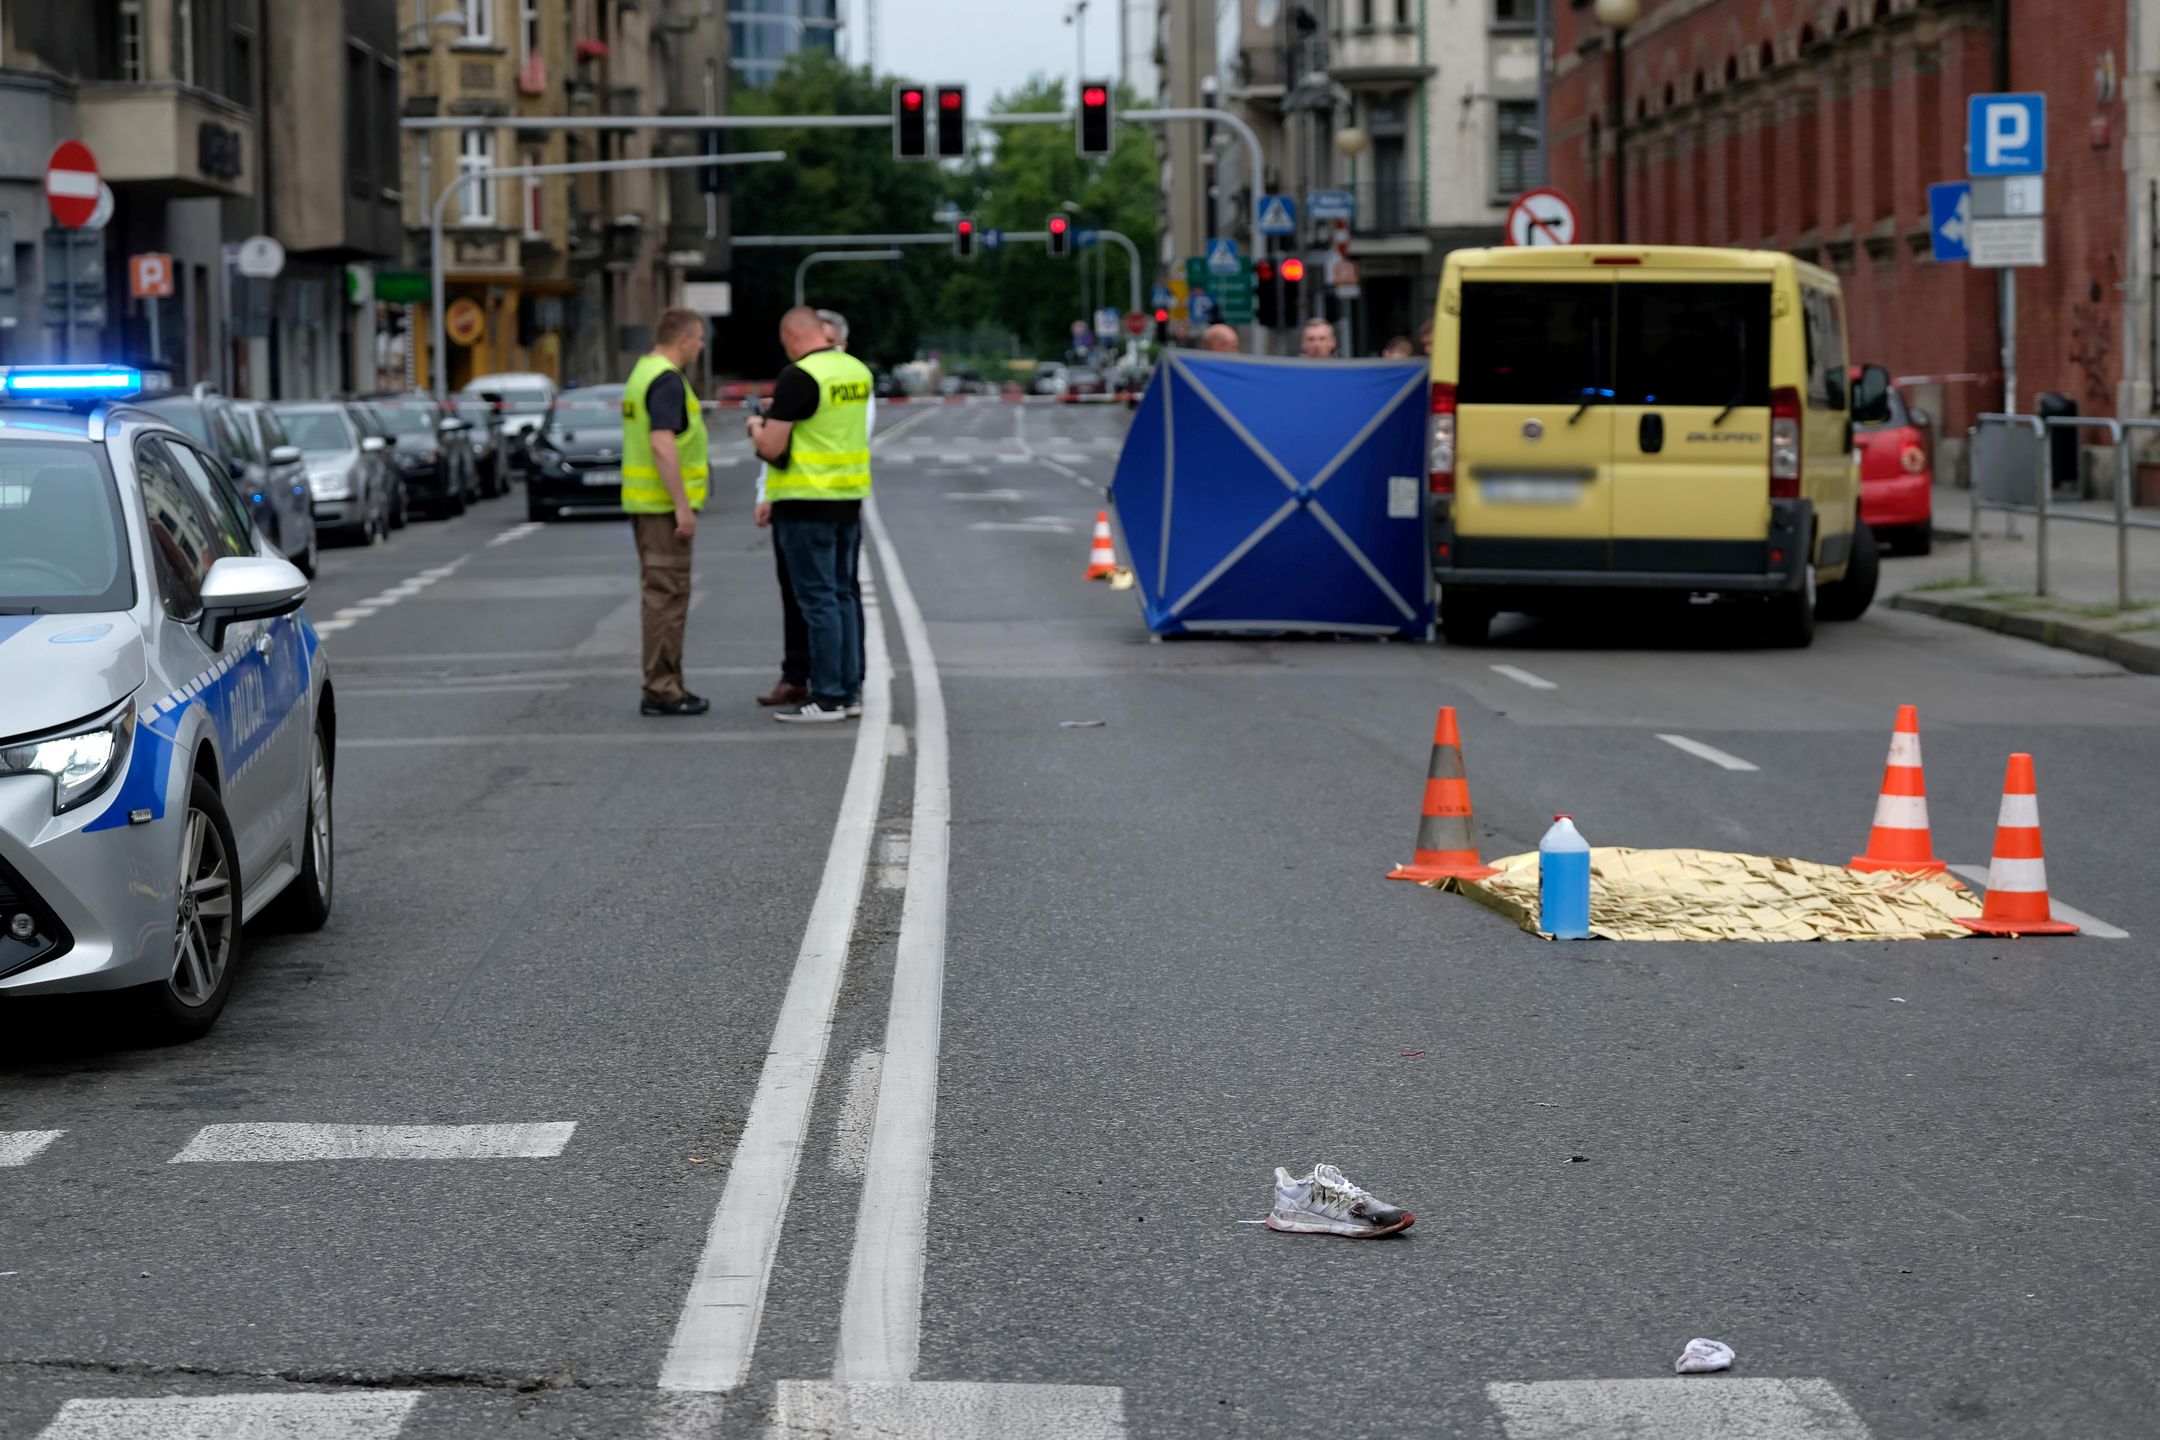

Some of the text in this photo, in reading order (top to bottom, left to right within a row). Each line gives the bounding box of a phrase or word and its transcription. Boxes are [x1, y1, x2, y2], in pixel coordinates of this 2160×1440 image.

[1986, 103, 2030, 167] P
[139, 259, 164, 292] P
[830, 383, 870, 405] POLICJ
[229, 664, 267, 752] POLICJA
